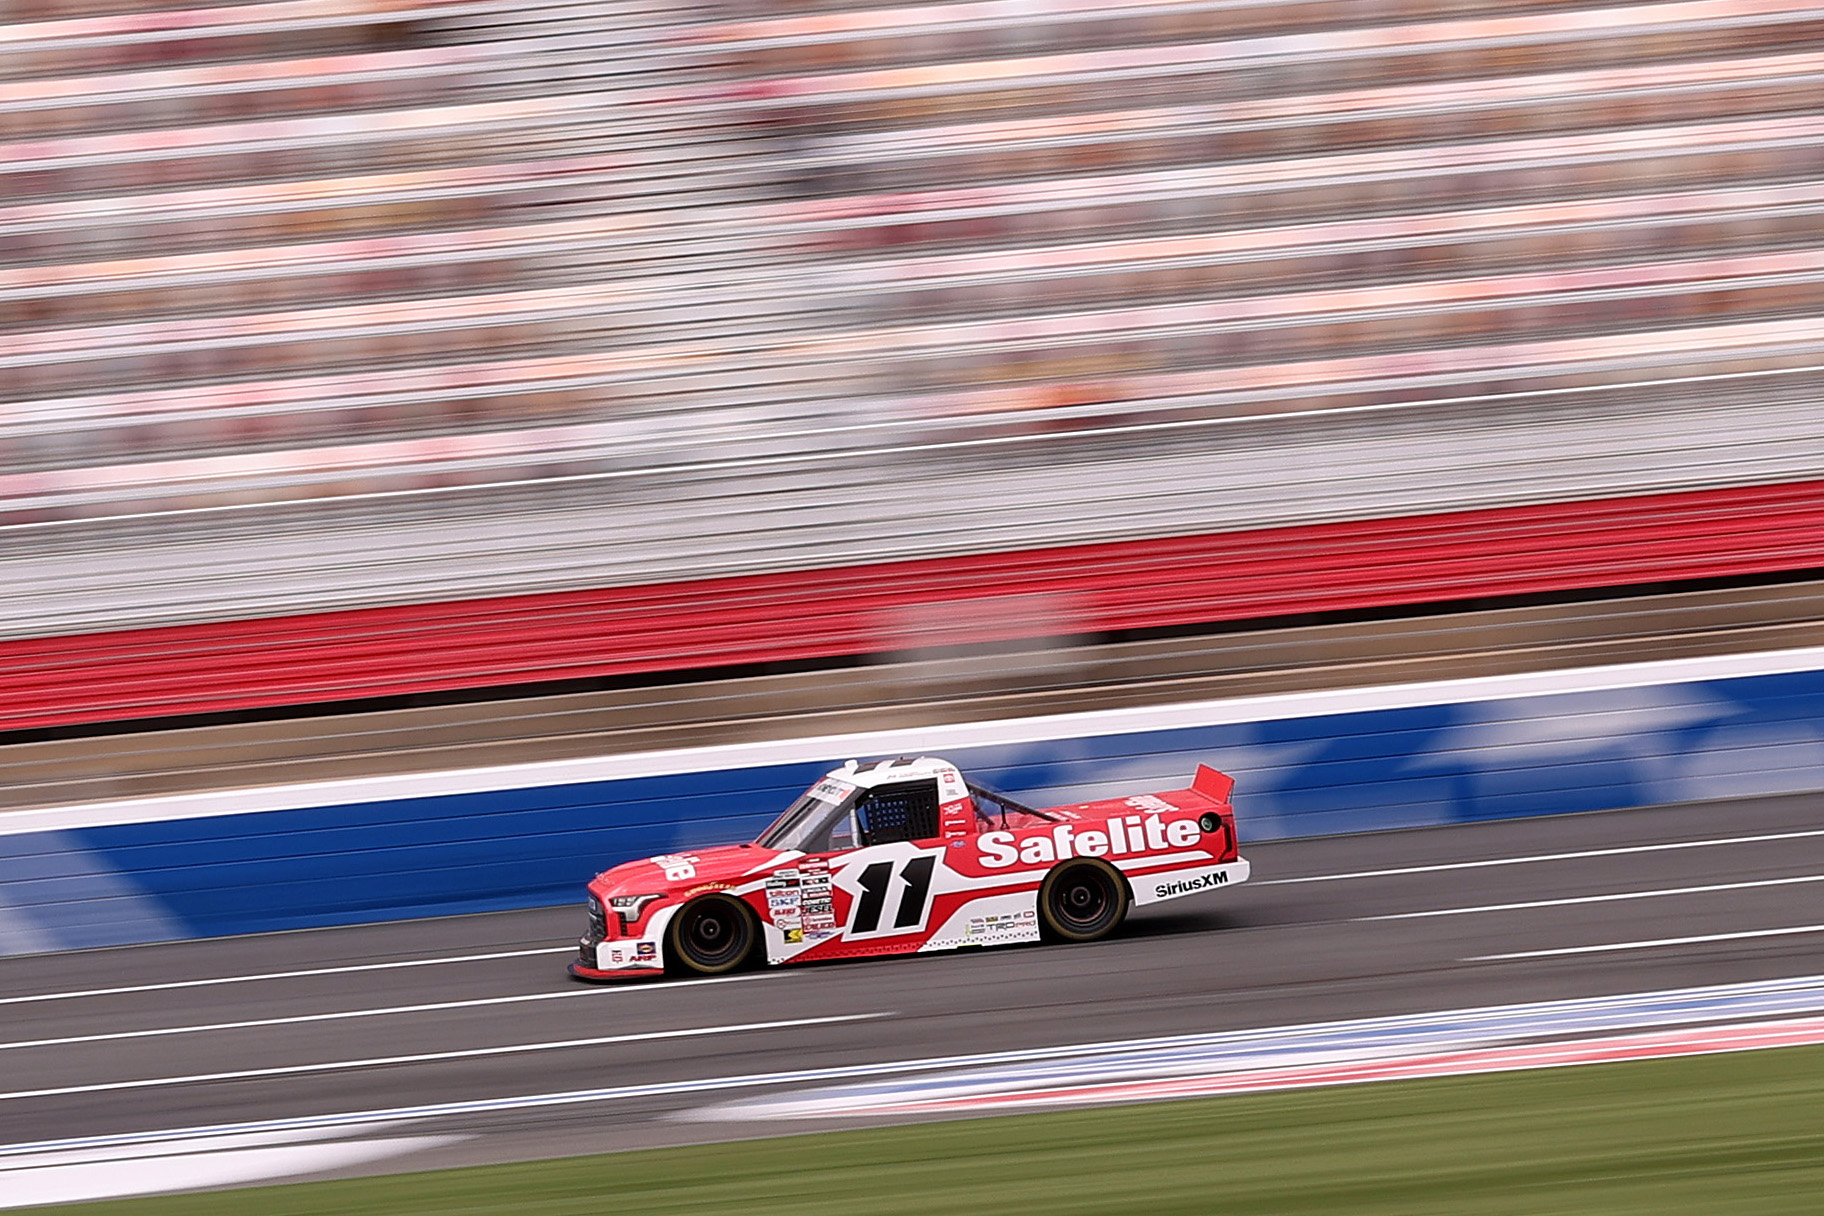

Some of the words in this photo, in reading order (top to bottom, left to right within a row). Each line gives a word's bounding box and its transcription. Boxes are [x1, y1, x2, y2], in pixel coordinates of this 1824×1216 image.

[977, 813, 1201, 868] Safelite
[770, 897, 799, 906] SKF
[851, 854, 937, 935] 11
[1155, 871, 1228, 897] SiriusXM
